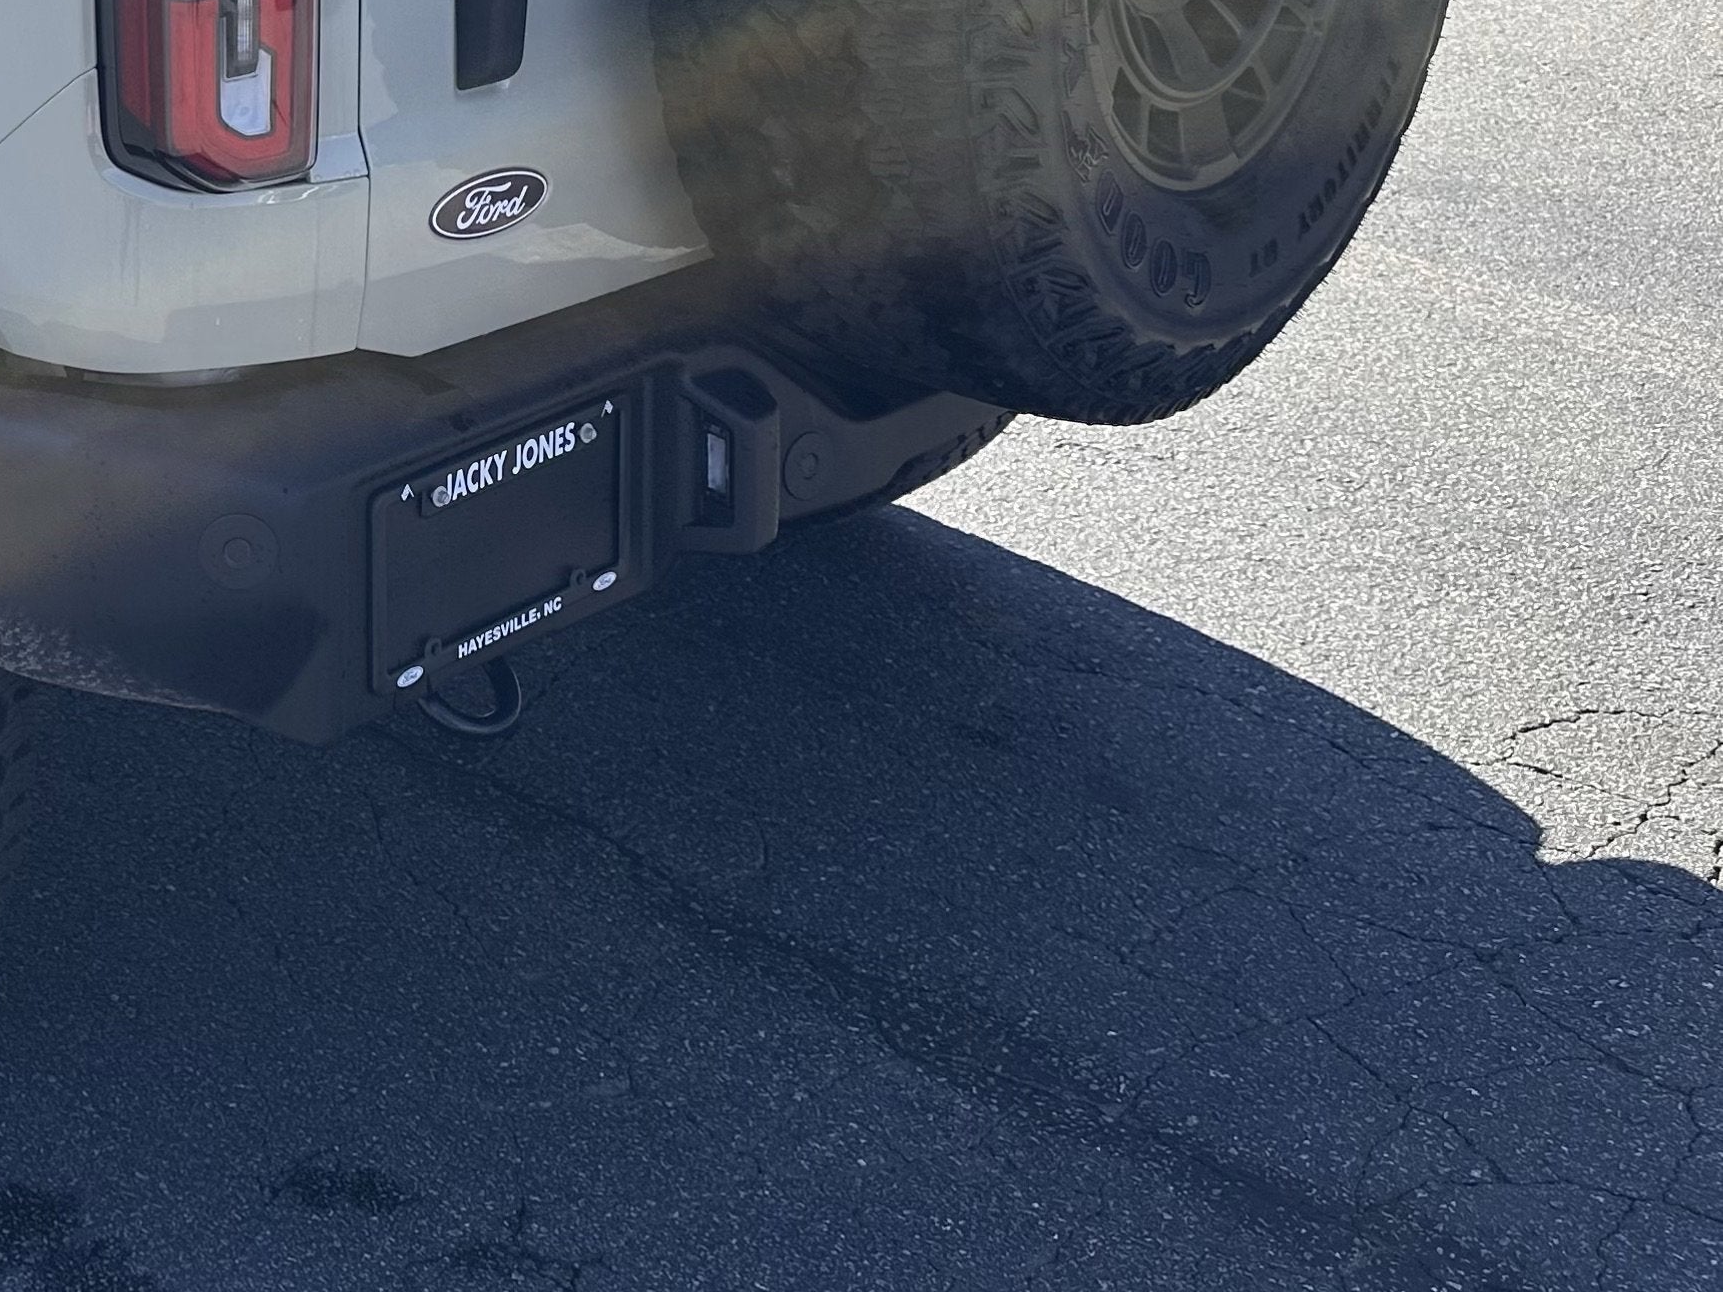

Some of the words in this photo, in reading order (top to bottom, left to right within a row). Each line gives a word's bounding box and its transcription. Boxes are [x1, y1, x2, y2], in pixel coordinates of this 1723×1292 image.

[456, 181, 528, 230] Ford
[445, 449, 508, 505] JACKY
[512, 422, 576, 475] JONES
[457, 607, 542, 659] HAYESVILLE,
[543, 596, 563, 619] NC
